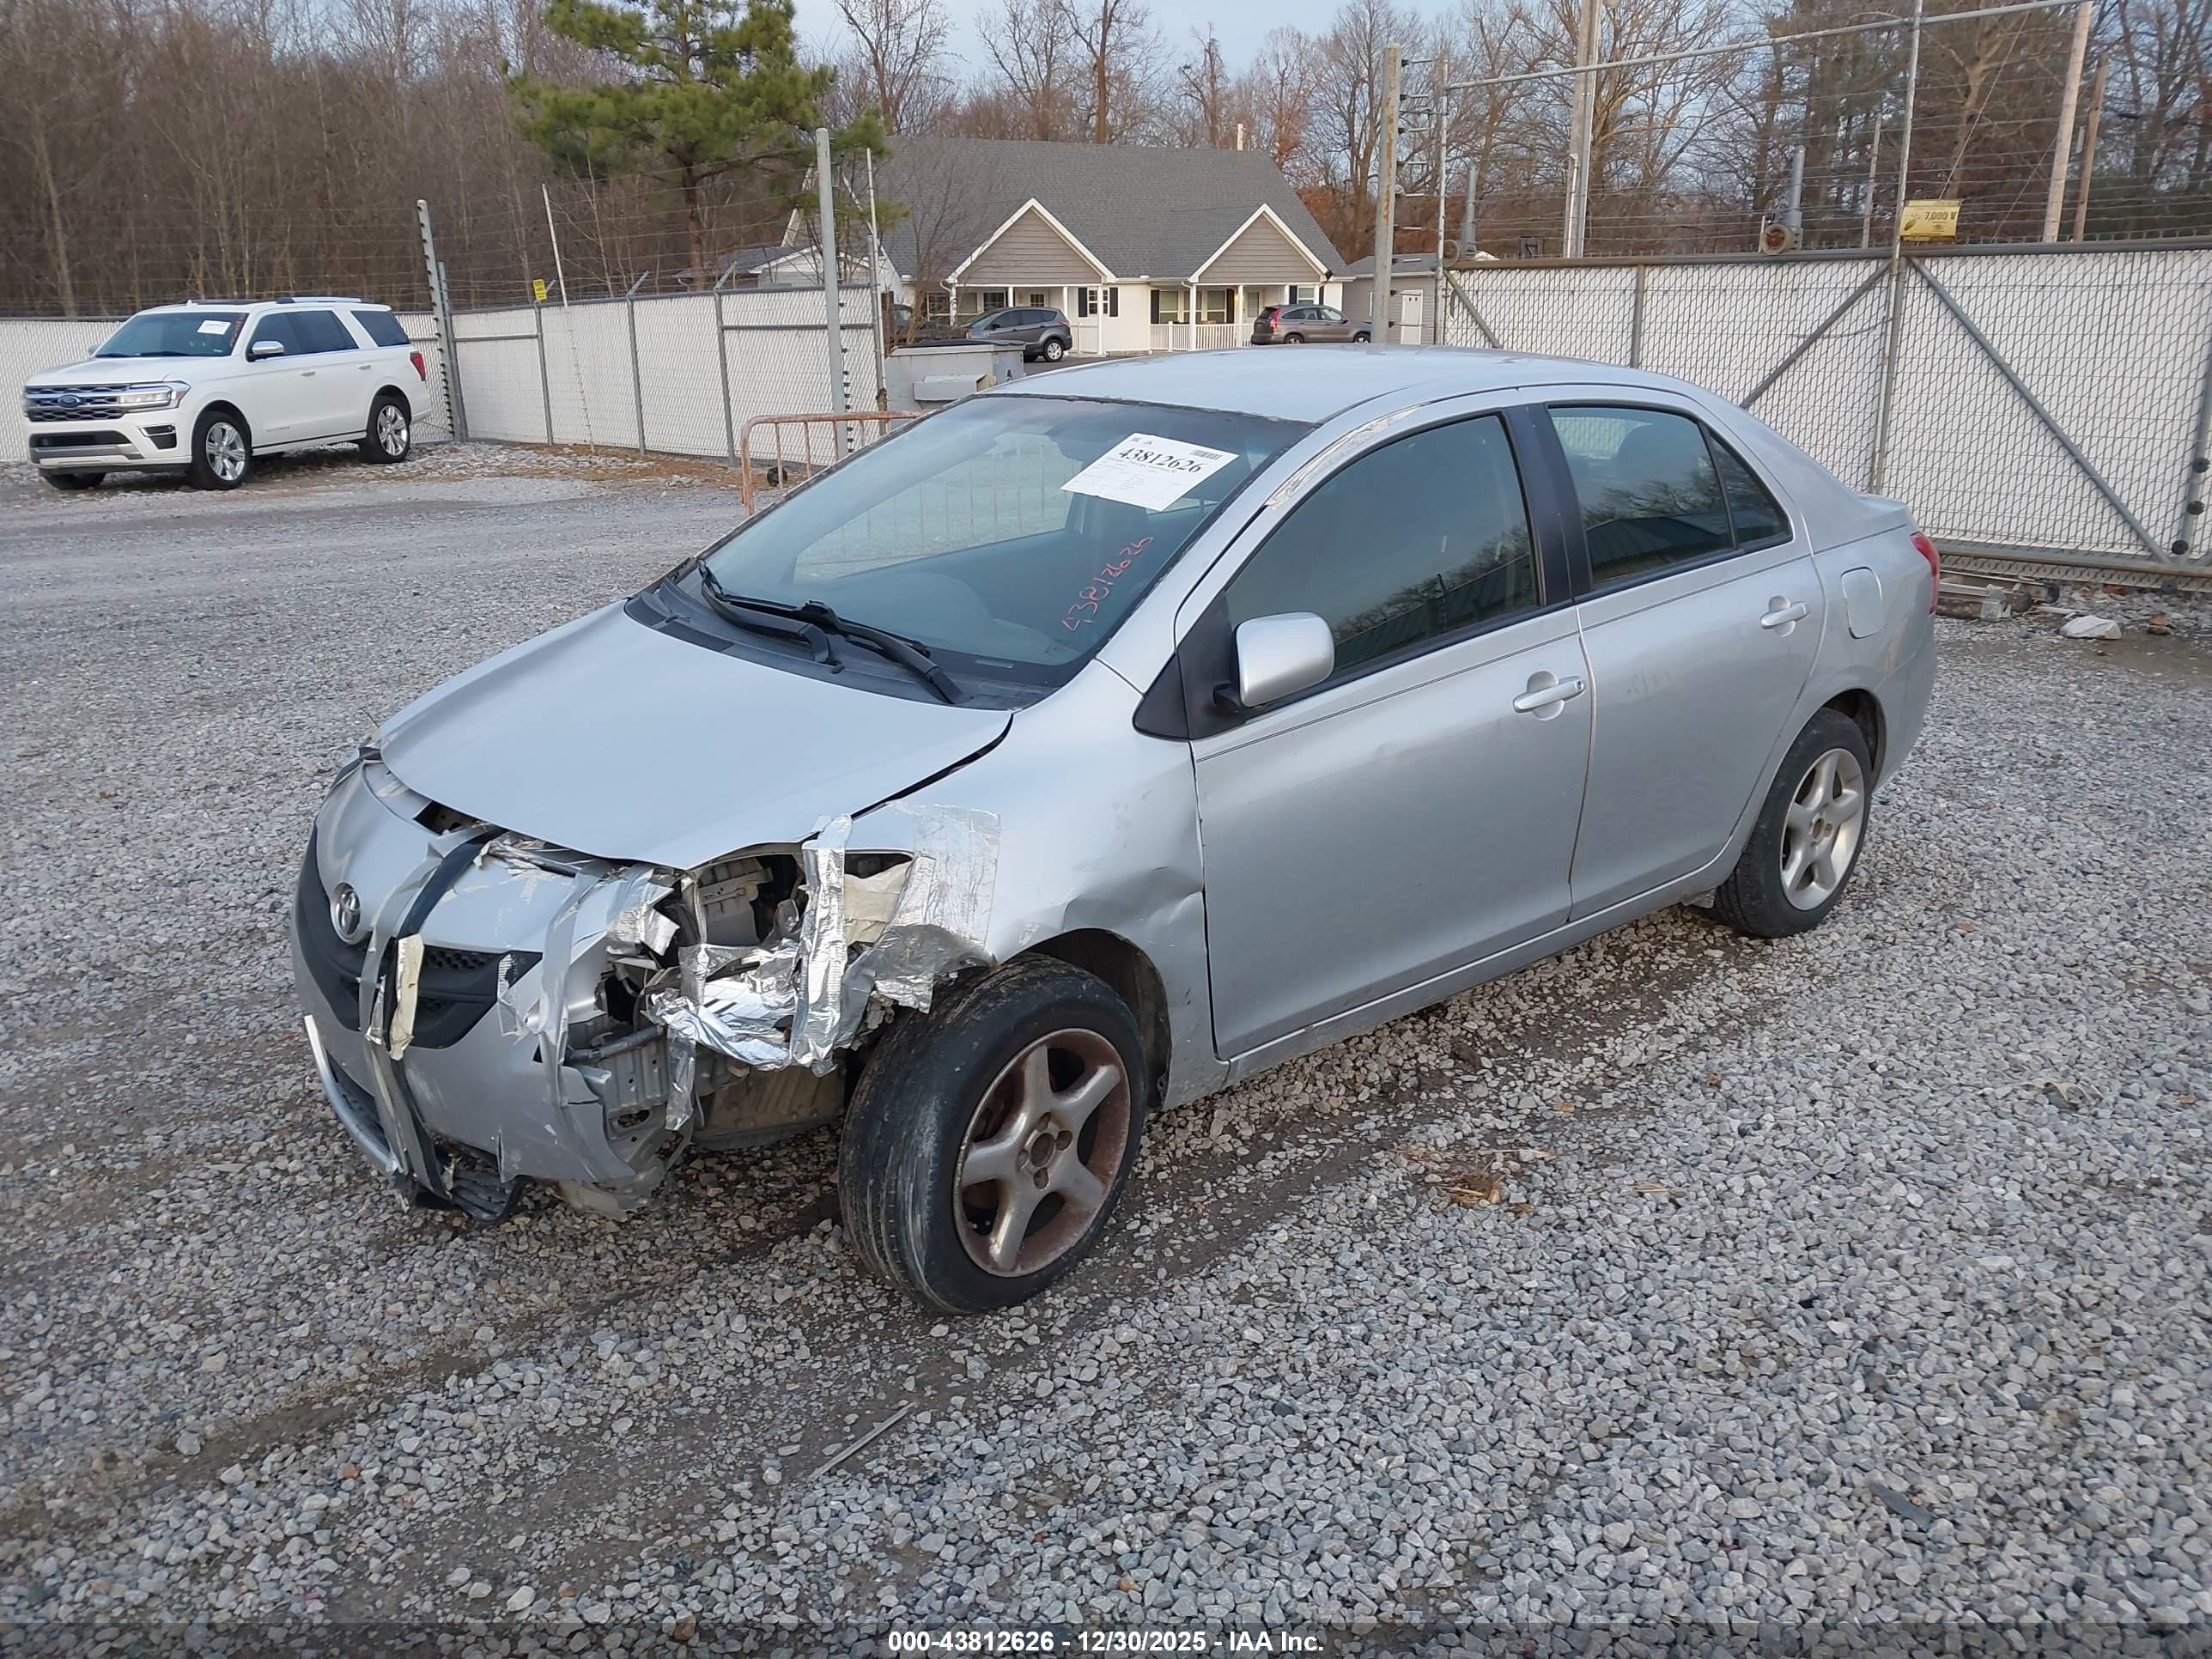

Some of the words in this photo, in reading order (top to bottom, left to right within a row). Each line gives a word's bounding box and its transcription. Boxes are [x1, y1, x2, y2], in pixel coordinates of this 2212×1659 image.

[1924, 211, 1948, 222] 7,000
[1950, 211, 1957, 221] V
[1118, 447, 1206, 473] 43812626
